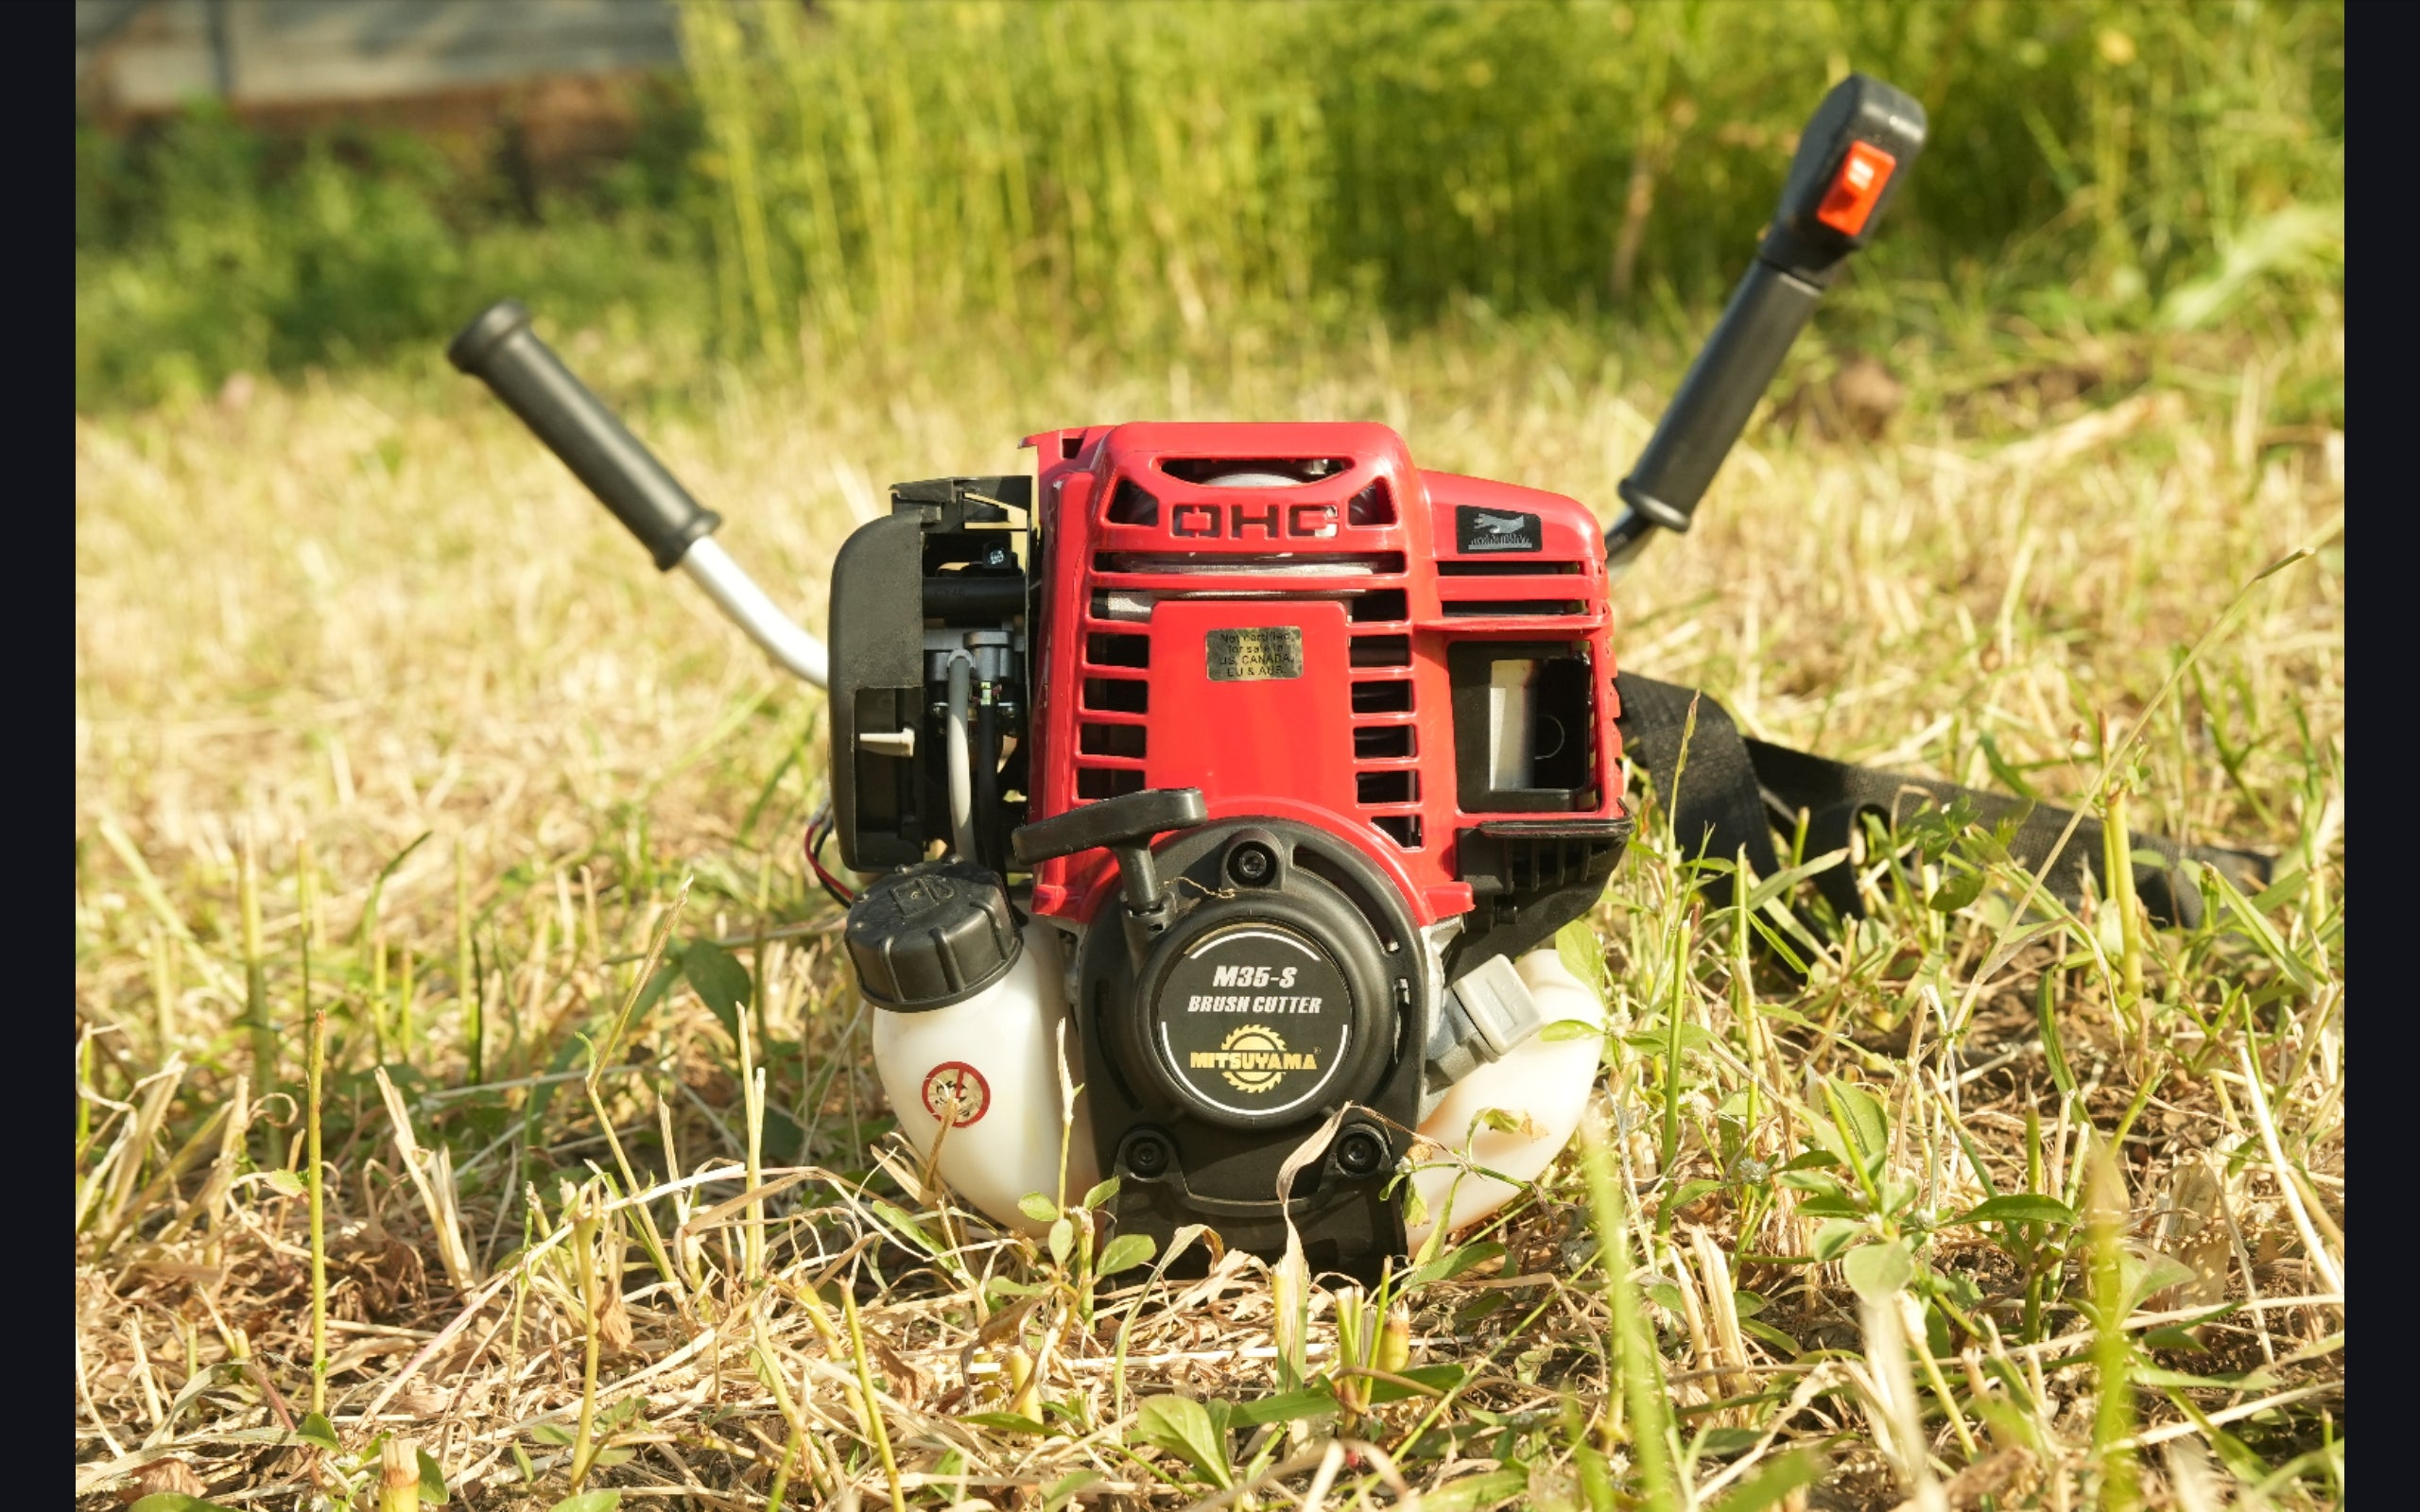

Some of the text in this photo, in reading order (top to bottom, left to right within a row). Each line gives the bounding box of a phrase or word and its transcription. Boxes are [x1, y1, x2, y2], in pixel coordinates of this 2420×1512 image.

[1171, 504, 1339, 538] OHC
[1228, 644, 1243, 654] for
[1227, 666, 1244, 678] EU
[1212, 966, 1298, 988] M35-S
[1187, 995, 1322, 1014] BRUSH CUTTER
[1190, 1051, 1317, 1071] MITSUYAMA
